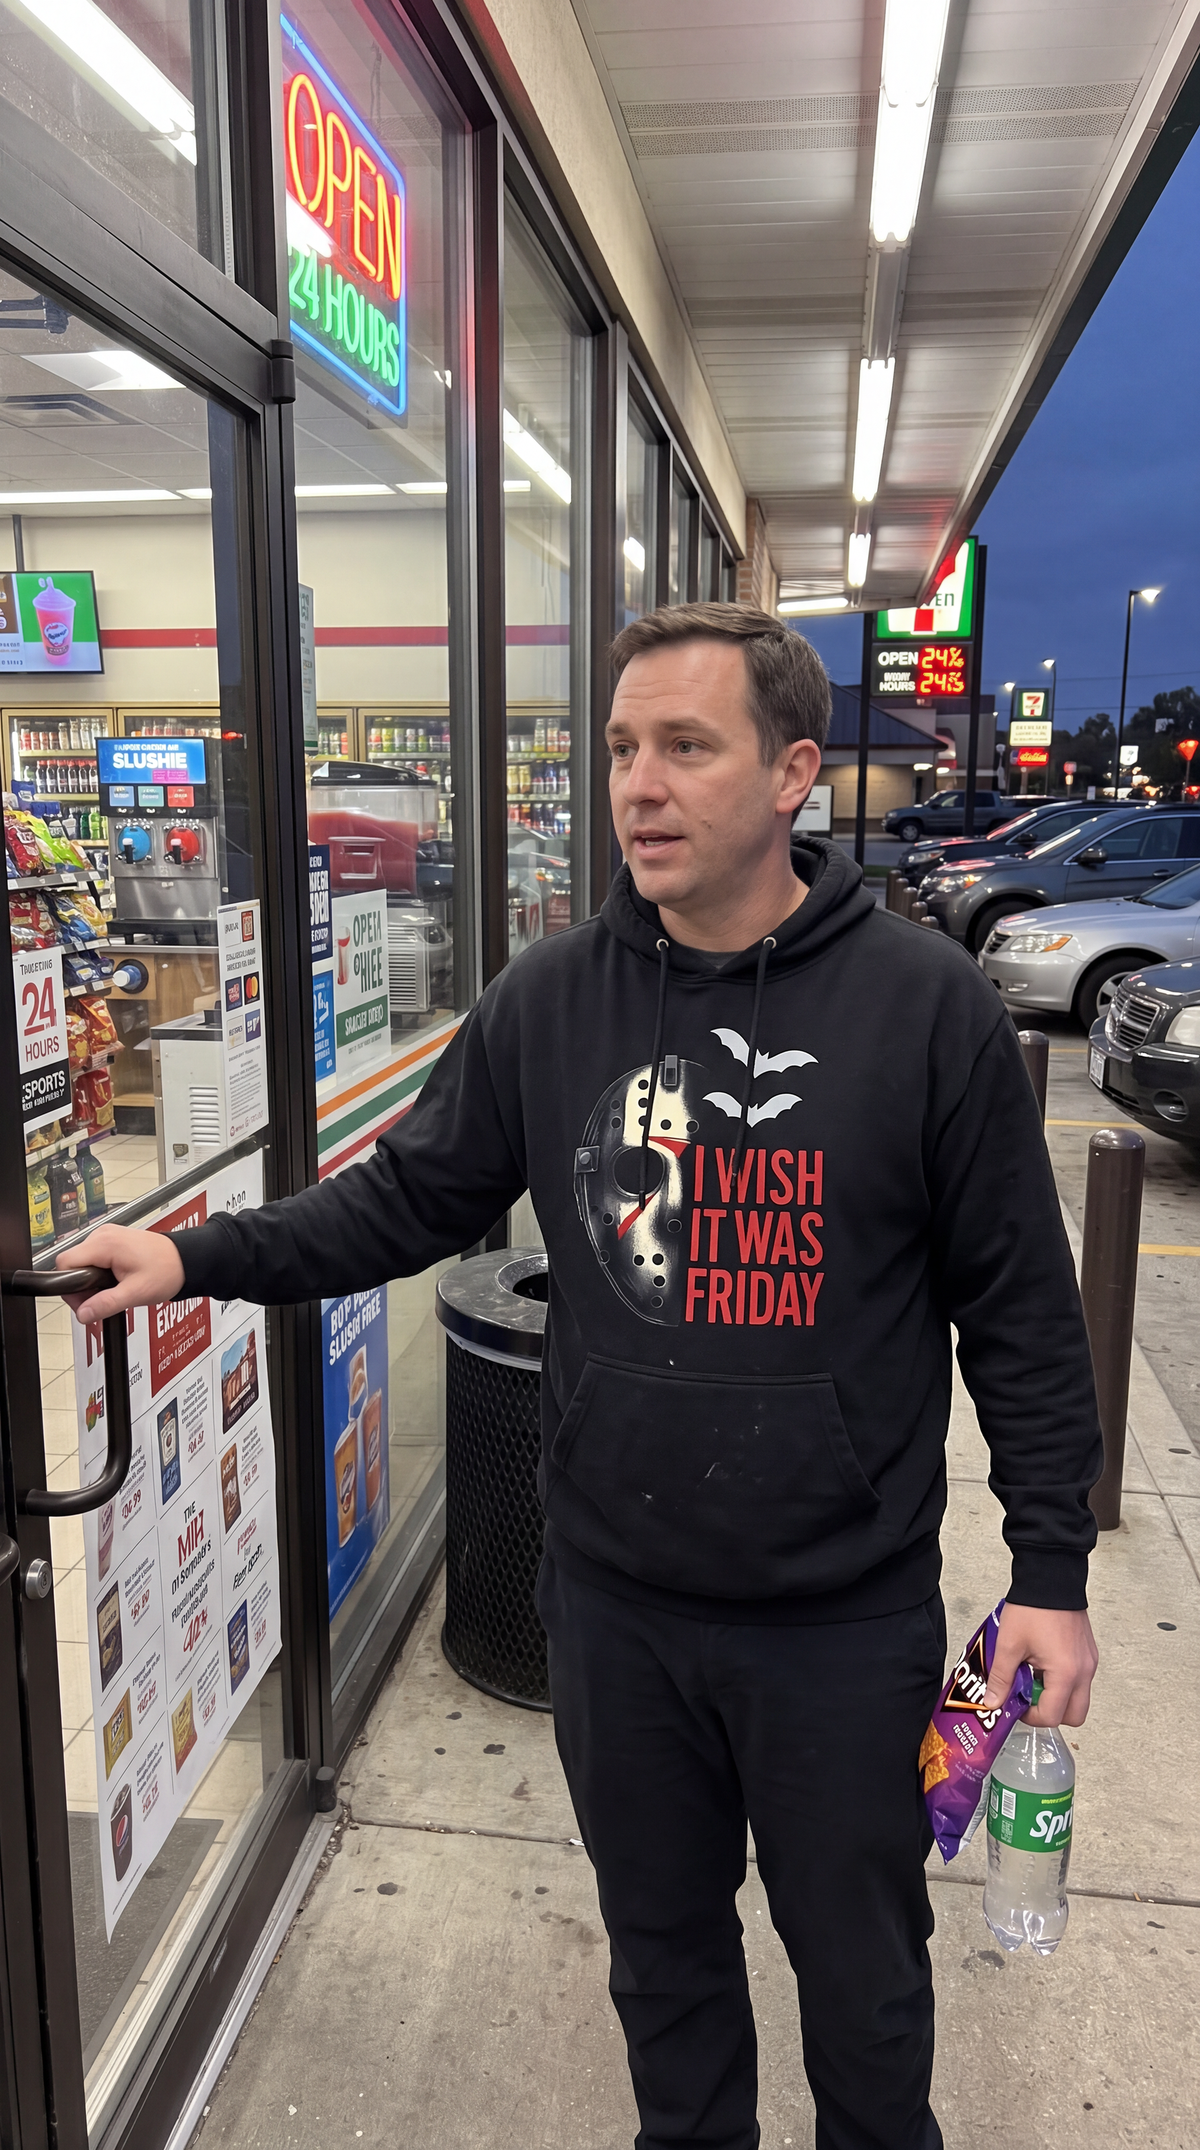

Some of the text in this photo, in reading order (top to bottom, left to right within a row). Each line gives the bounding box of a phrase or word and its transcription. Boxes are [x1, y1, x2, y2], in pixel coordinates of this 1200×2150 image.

[288, 74, 401, 300] OPEN
[288, 243, 400, 387] 24 HOURS
[878, 651, 919, 666] OPEN
[879, 681, 916, 692] HOURS
[112, 752, 188, 769] SLUSHIE
[22, 976, 57, 1037] 24
[25, 1035, 60, 1063] HOURS
[693, 1144, 824, 1206] I WISH
[689, 1207, 824, 1266] IT WAS
[362, 1291, 381, 1330] FREE
[685, 1267, 825, 1327] FRIDAY
